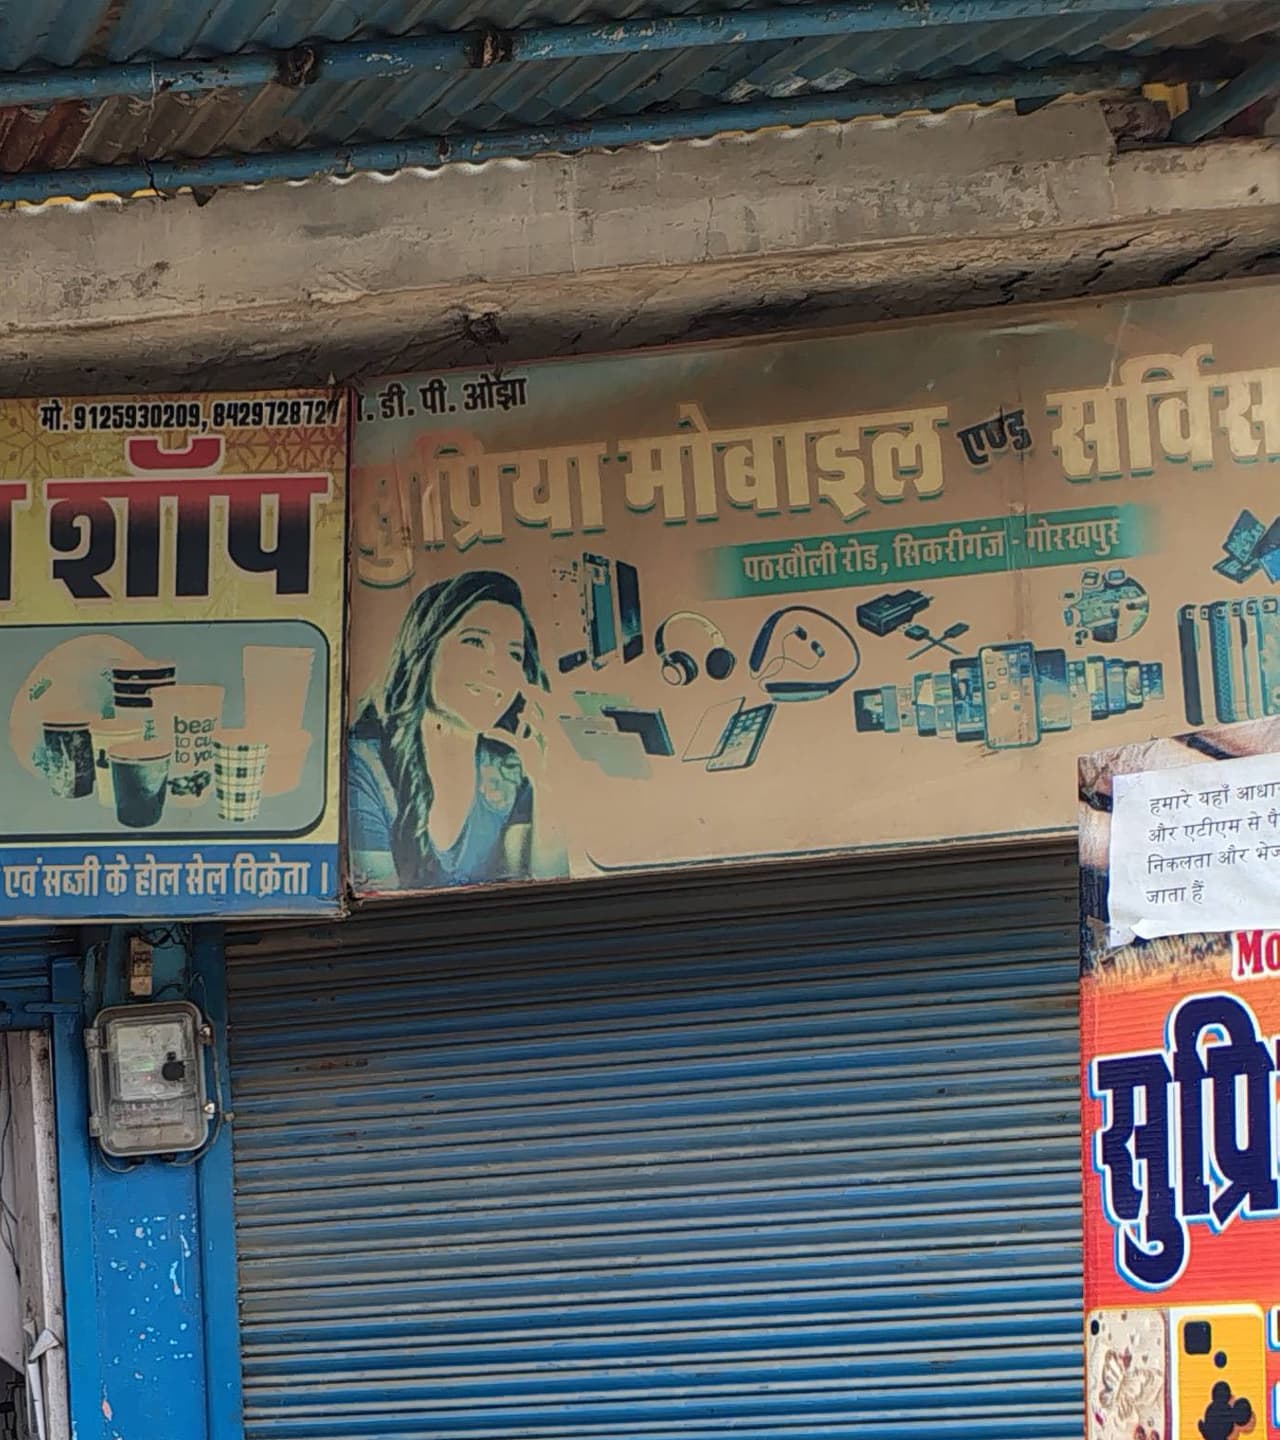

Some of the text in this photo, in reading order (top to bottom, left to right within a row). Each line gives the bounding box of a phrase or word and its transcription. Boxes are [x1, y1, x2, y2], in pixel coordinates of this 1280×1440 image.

[73, 402, 208, 433] 9125930209,
[618, 406, 950, 523] मोबाइल
[46, 434, 328, 602] शॉप
[842, 538, 890, 577] रोड,
[893, 526, 1006, 567] सिकरीगंज
[1024, 515, 1122, 556] गोरखपुर
[1149, 782, 1280, 815] हमारे यहाँ आधा
[1148, 821, 1179, 843] और
[1183, 817, 1241, 842] एटीएम
[1247, 811, 1262, 830] से
[42, 853, 102, 897] सब्जी
[105, 853, 128, 897] के
[133, 853, 180, 897] होल
[185, 853, 229, 897] सेल
[233, 851, 311, 898] विक्रेता
[1147, 844, 1249, 875] निकलता और
[1146, 879, 1205, 905] जाता हैं
[1092, 993, 1280, 1288] सुप्रि
